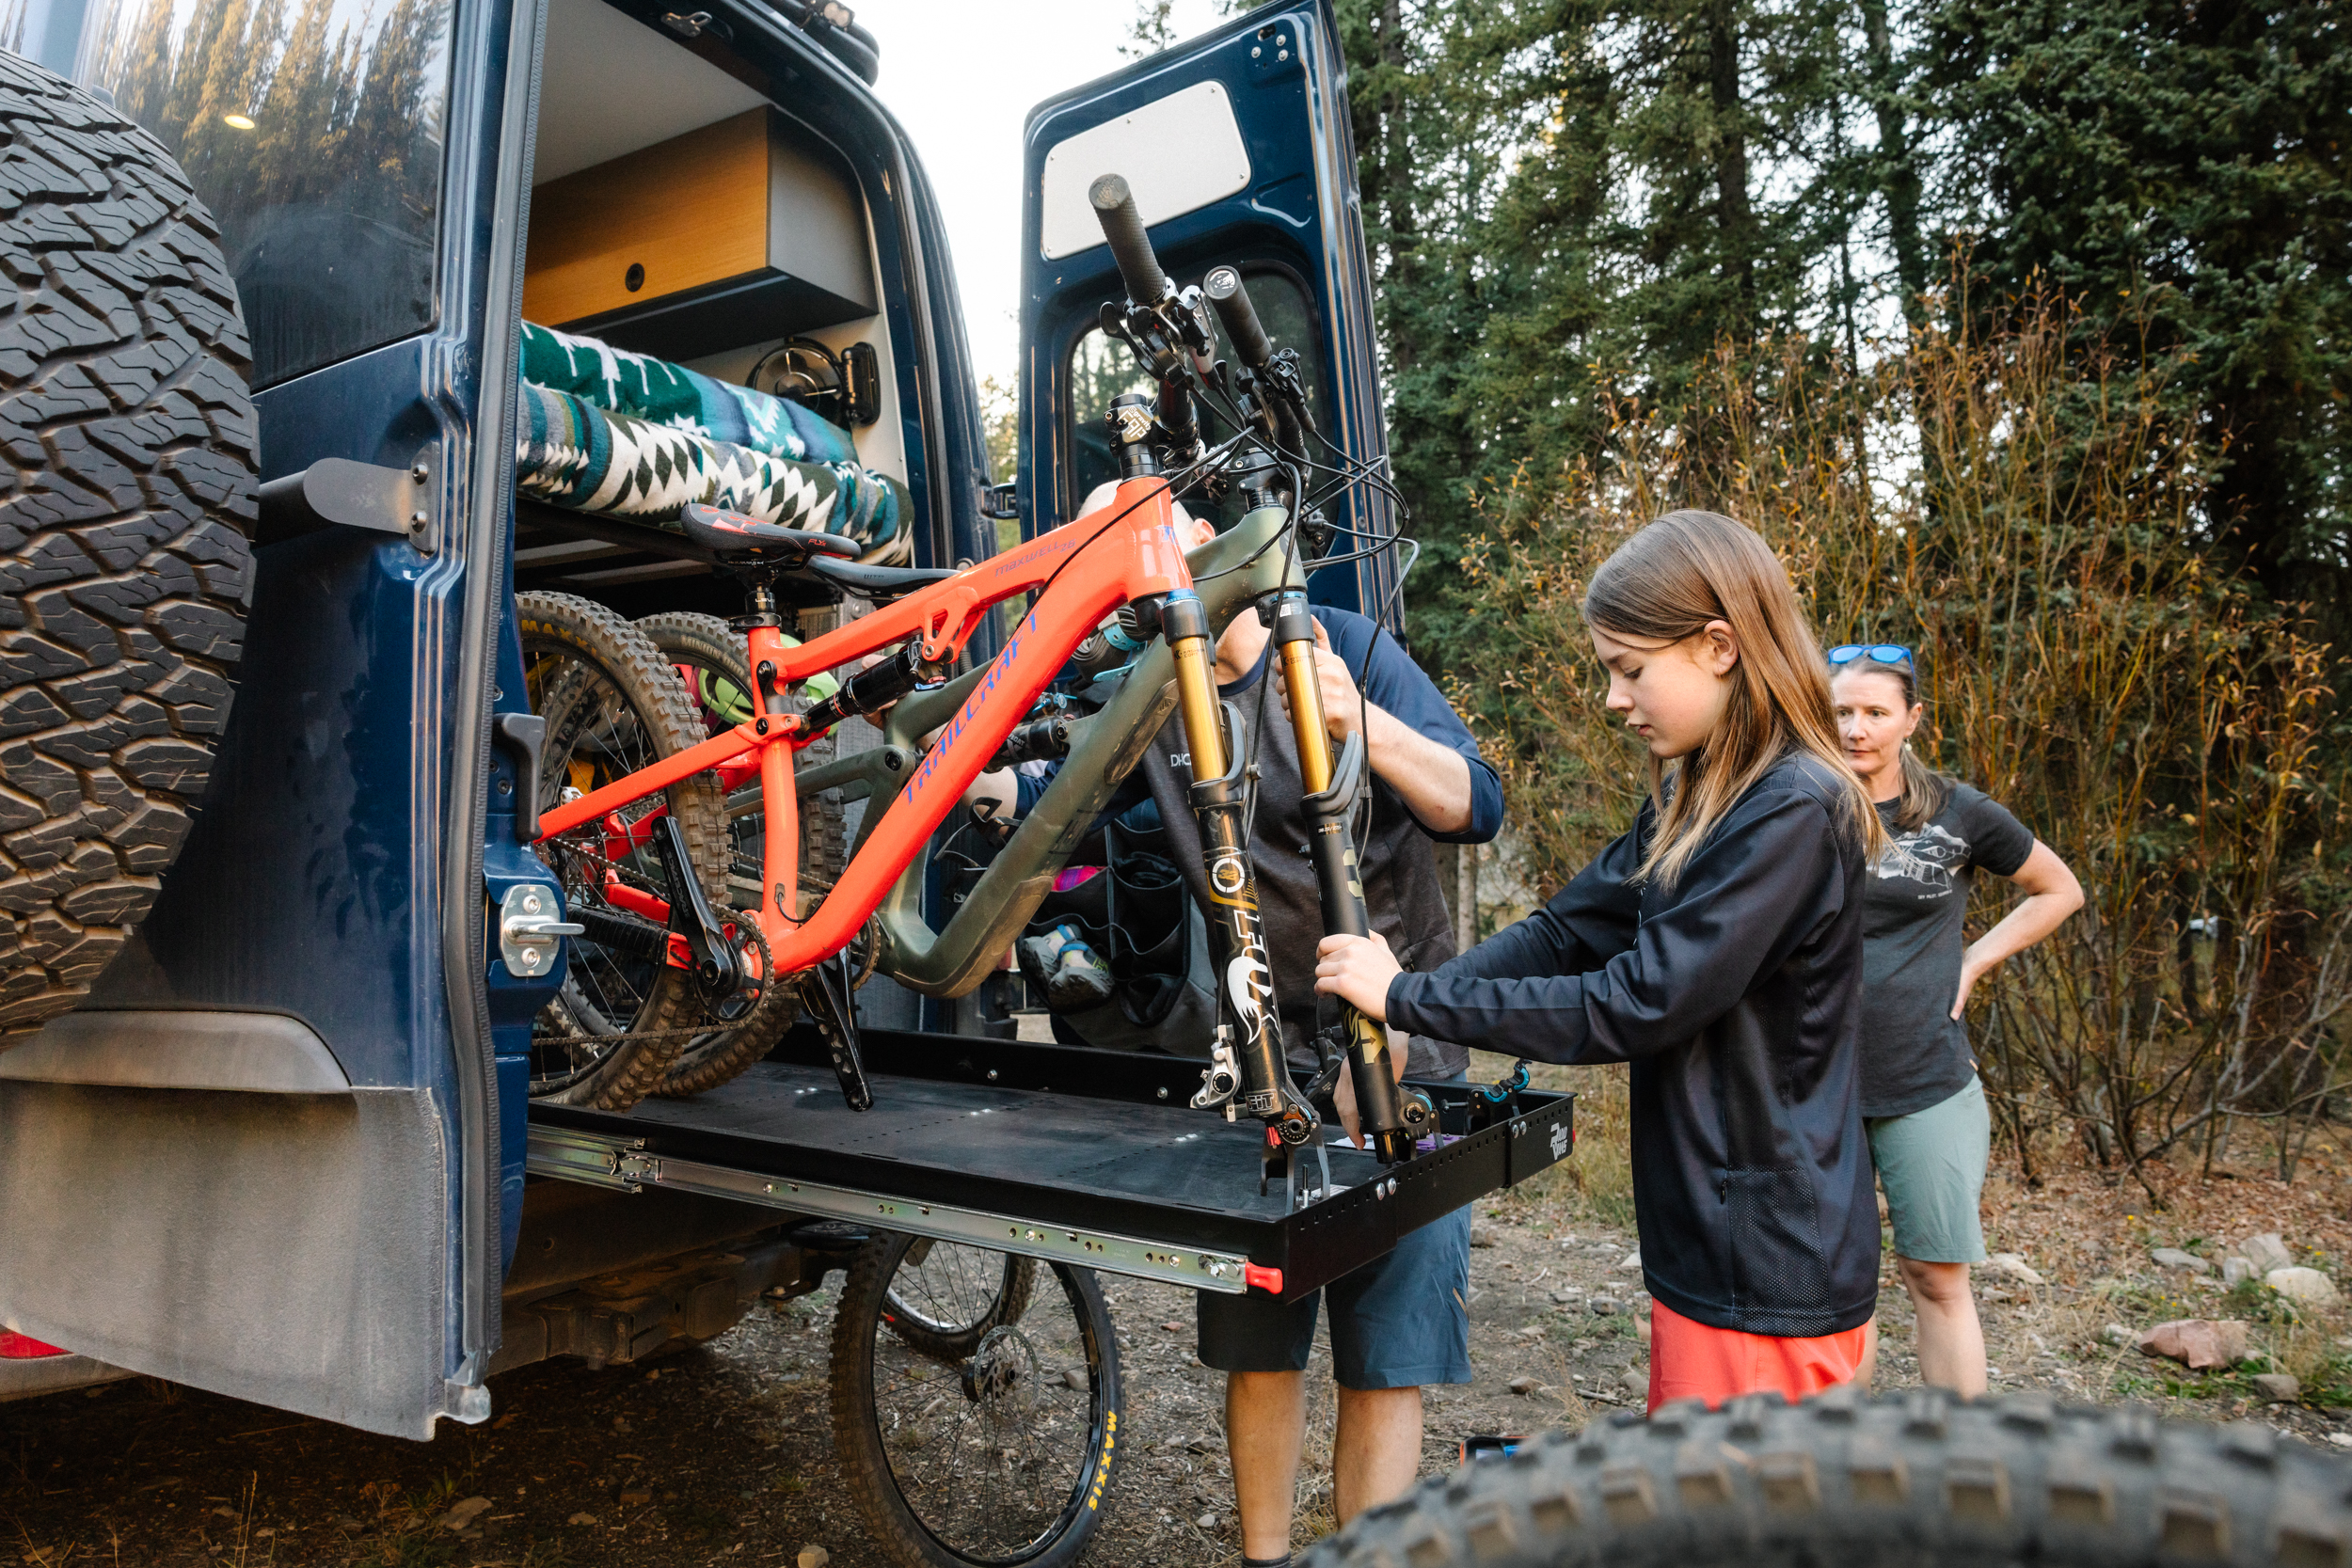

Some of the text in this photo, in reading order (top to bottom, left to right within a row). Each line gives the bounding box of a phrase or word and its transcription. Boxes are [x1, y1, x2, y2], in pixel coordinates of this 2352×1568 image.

[1133, 410, 1152, 431] gravity
[903, 607, 1040, 804] TRAILCRAFT
[1008, 734, 1025, 747] FLOAT
[1087, 1410, 1118, 1512] MAXXIS
